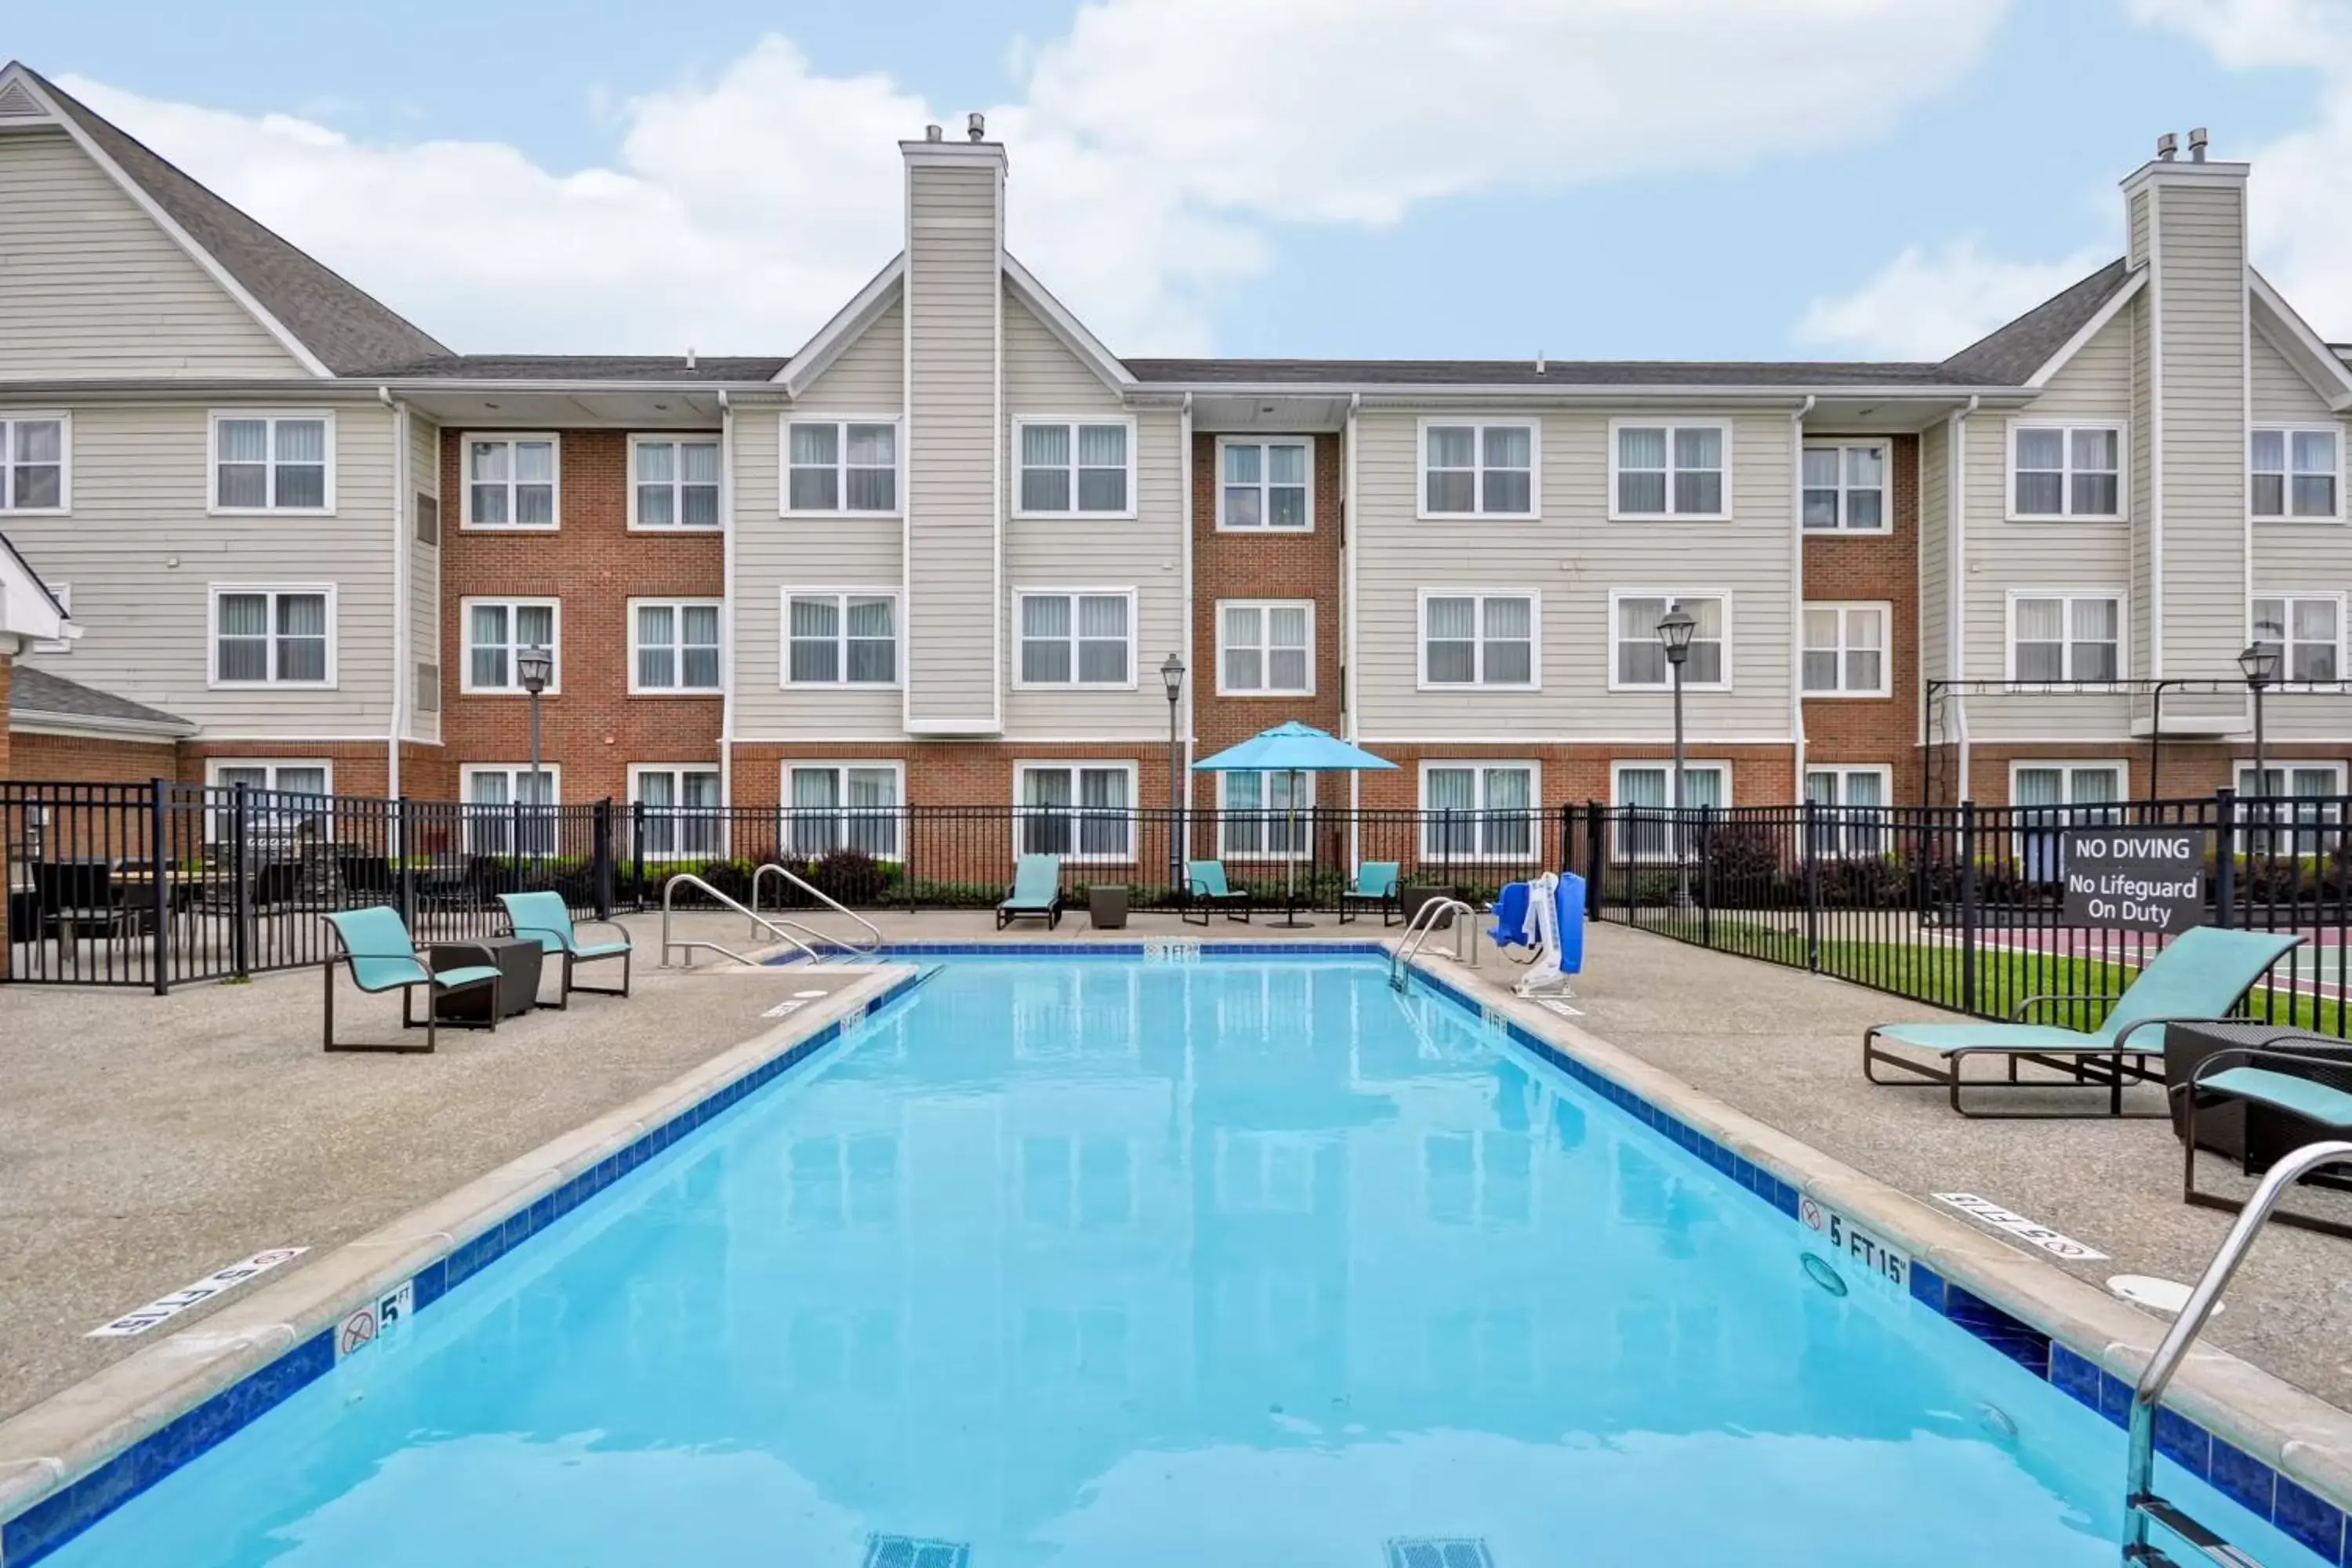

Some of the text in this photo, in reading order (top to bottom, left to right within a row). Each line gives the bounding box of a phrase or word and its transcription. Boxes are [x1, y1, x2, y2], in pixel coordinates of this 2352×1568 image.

[2076, 838, 2190, 858] NO DIVING
[2070, 874, 2198, 901] No Lifeguard
[2088, 899, 2172, 928] On Duty
[1831, 1213, 1842, 1248] 5
[1850, 1230, 1875, 1268] FT
[381, 1294, 398, 1330] 5
